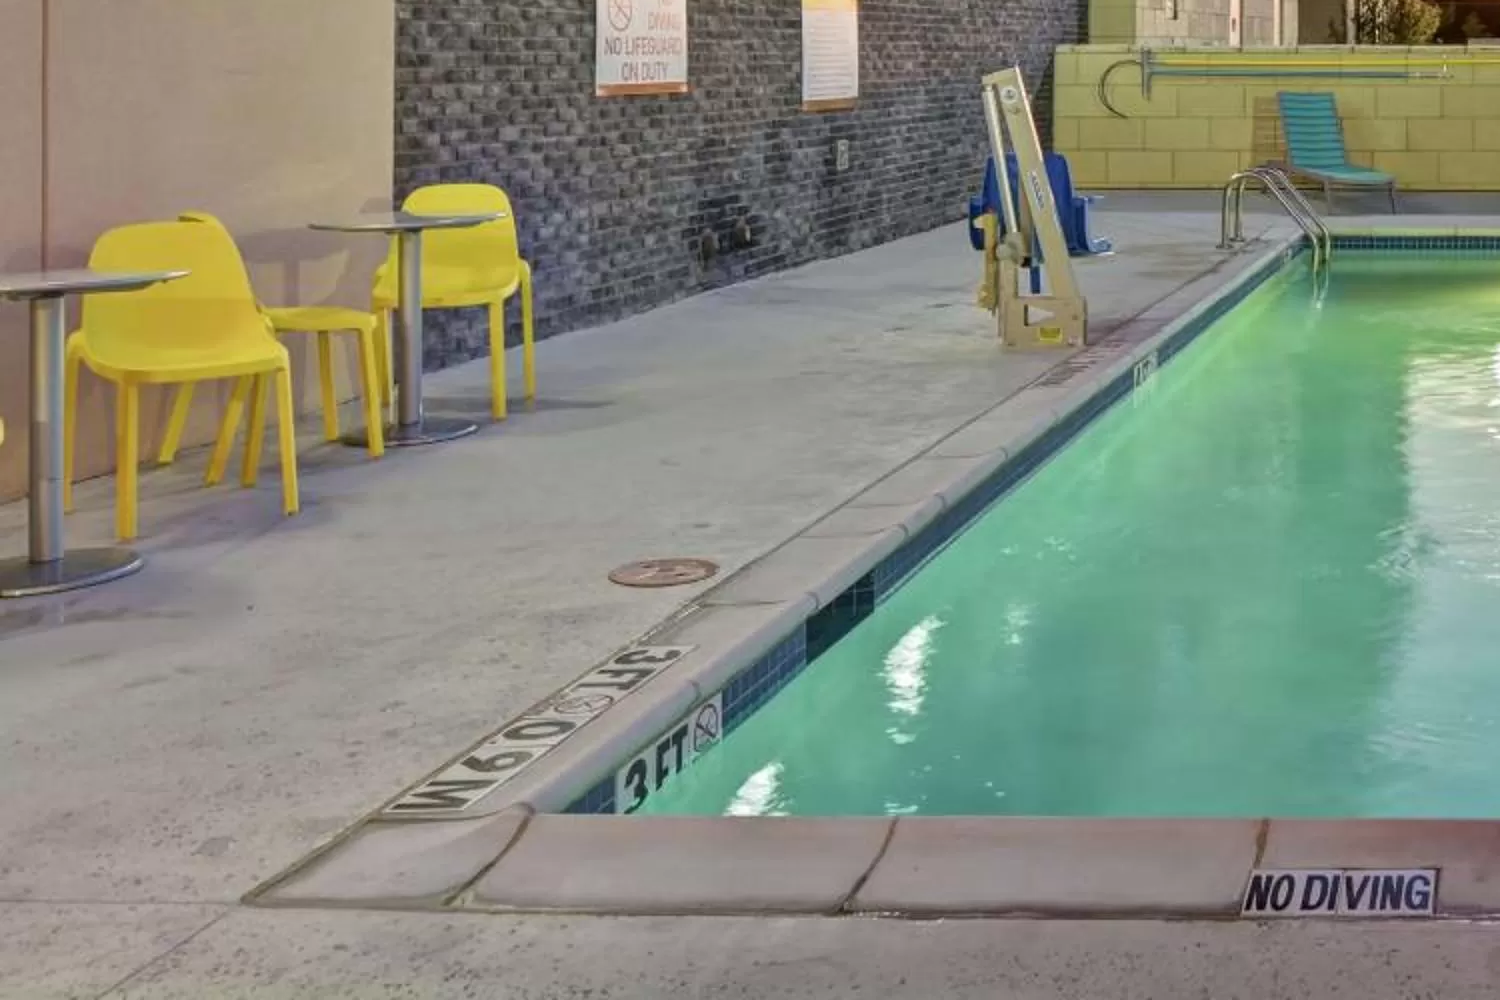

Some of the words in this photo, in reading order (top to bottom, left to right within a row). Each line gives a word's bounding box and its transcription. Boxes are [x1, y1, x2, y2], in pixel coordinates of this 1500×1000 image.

[647, 12, 682, 31] DIVI
[604, 36, 623, 56] NO
[621, 61, 638, 82] ON
[641, 61, 669, 81] DUTY
[623, 758, 649, 815] 3
[655, 723, 691, 792] FT
[1244, 874, 1295, 911] NO
[1299, 874, 1431, 911] DIVING
